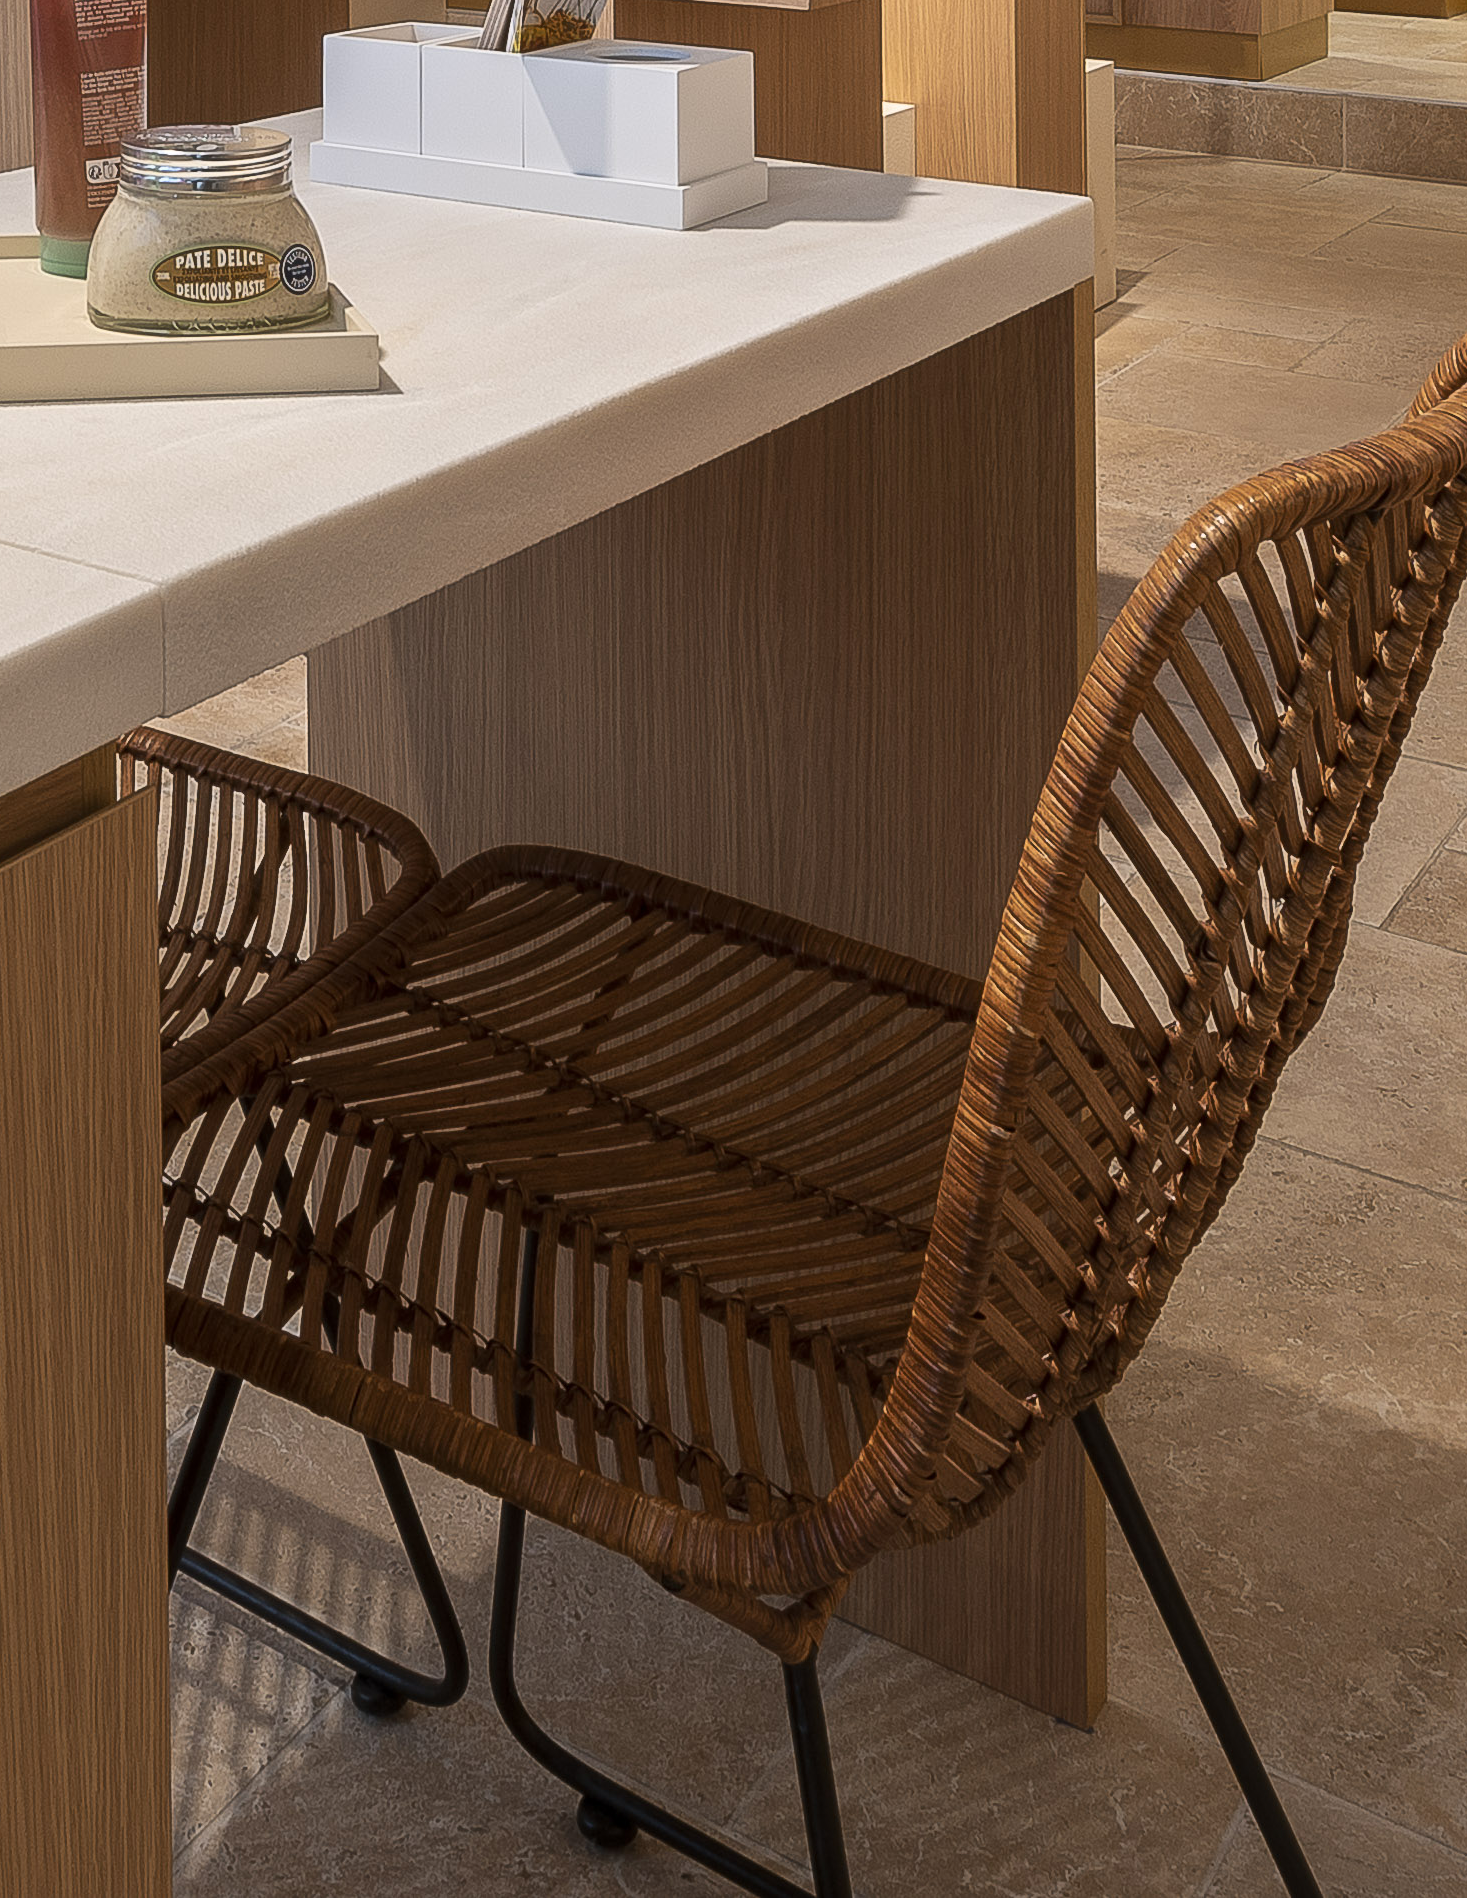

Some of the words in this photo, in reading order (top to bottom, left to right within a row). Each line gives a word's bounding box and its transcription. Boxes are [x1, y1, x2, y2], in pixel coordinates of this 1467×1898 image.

[175, 250, 211, 269] PATE
[217, 248, 264, 267] DELICE
[287, 250, 308, 264] TESTEUR
[176, 281, 232, 301] DELICIOUS
[234, 279, 266, 300] PASTE
[291, 275, 309, 288] TESTER
